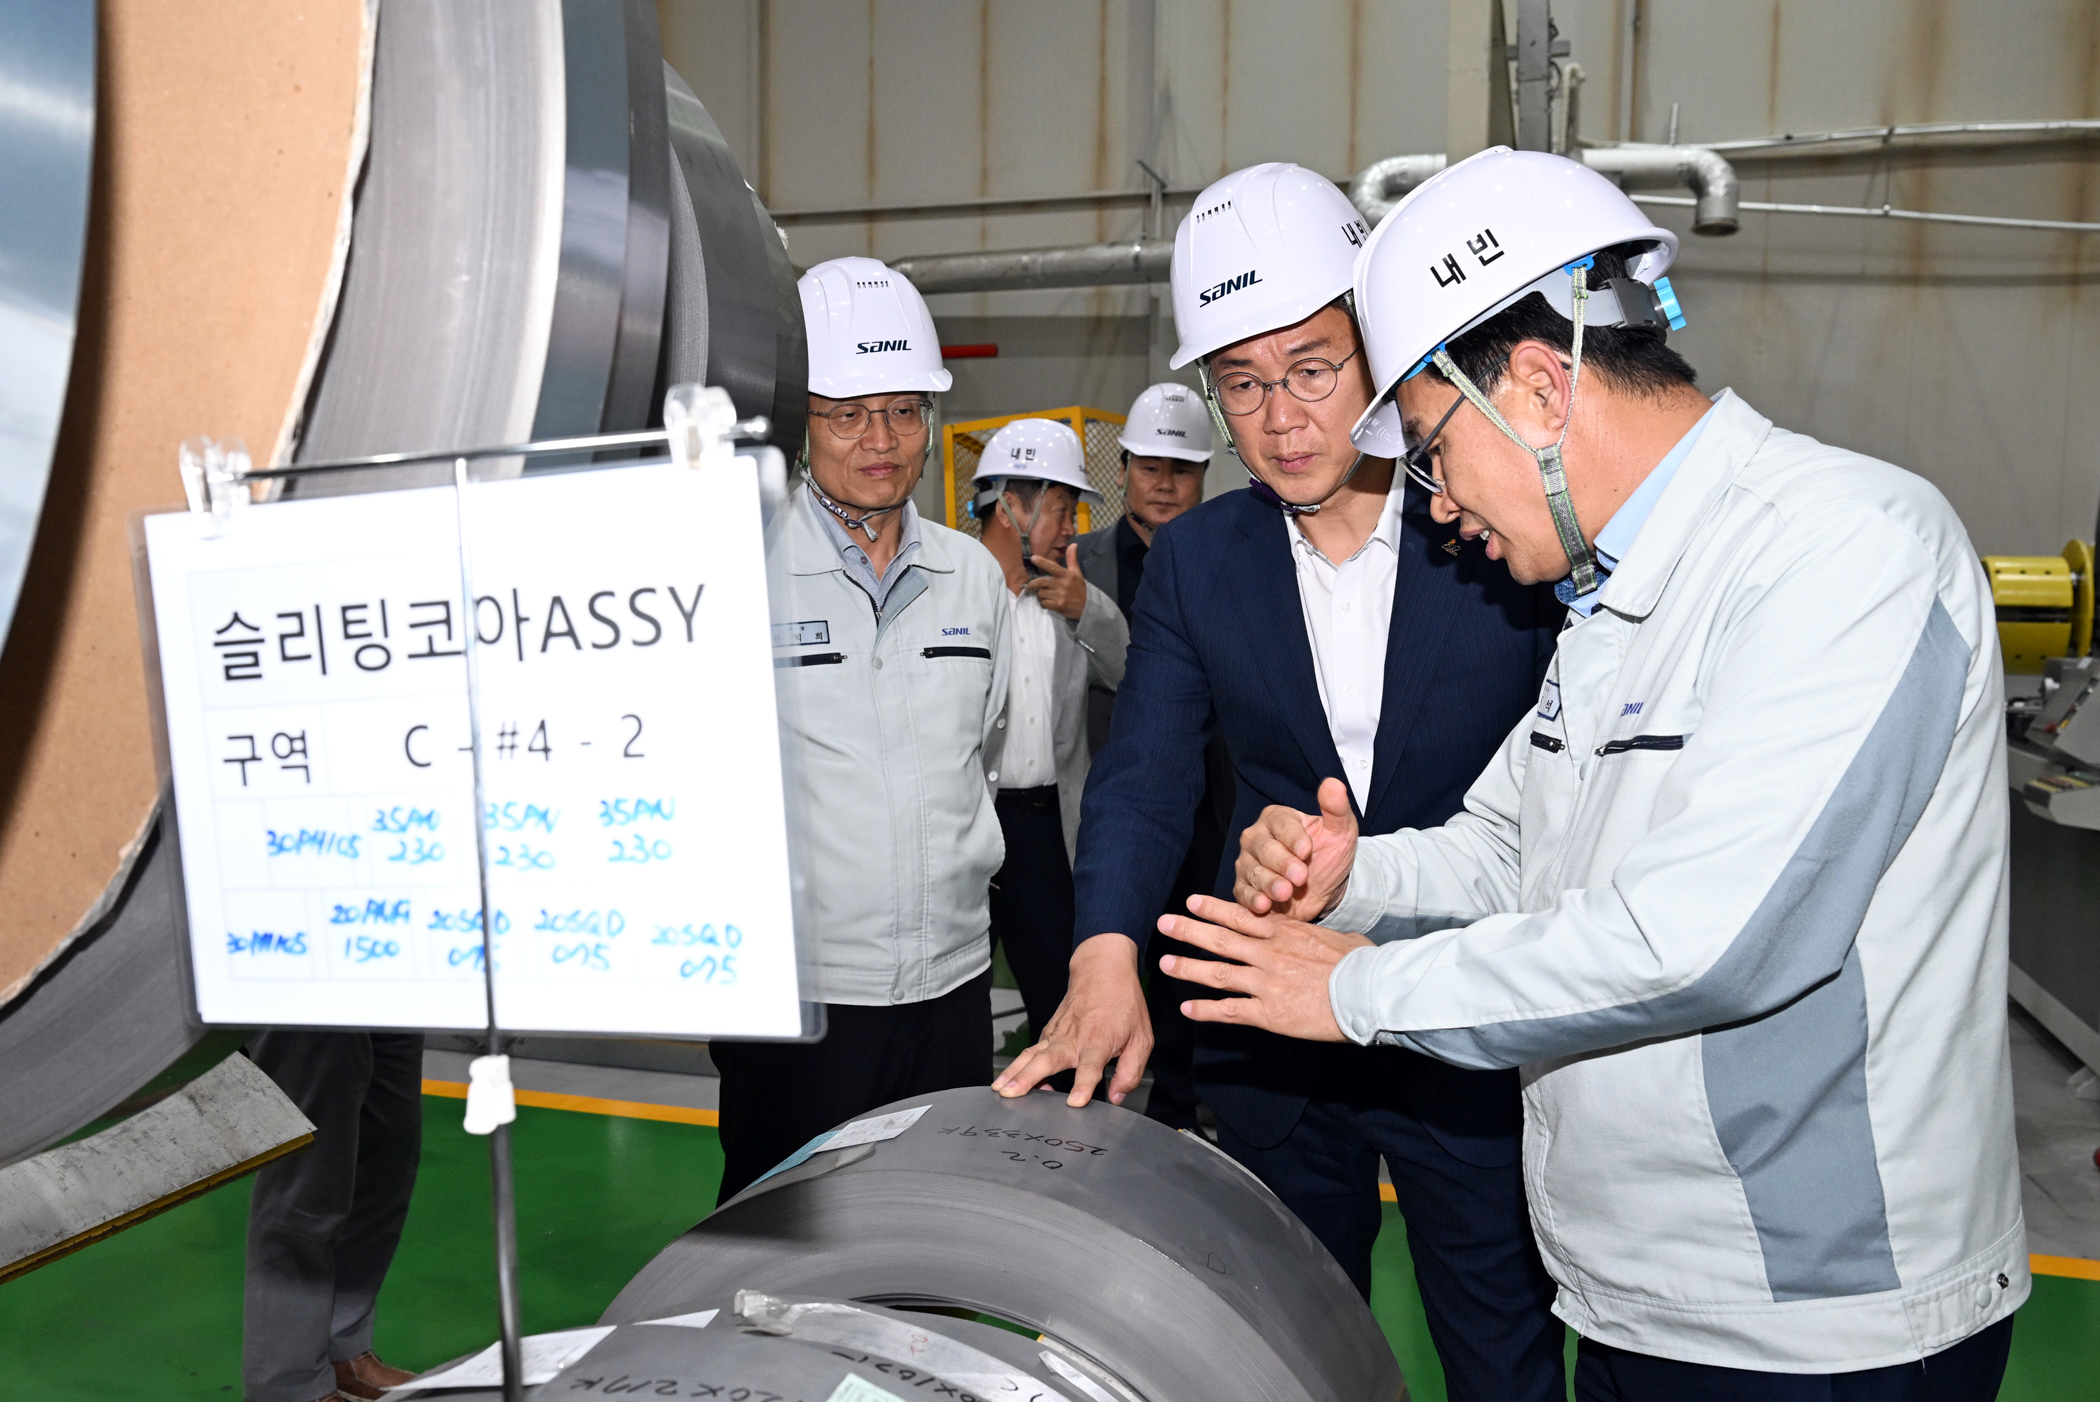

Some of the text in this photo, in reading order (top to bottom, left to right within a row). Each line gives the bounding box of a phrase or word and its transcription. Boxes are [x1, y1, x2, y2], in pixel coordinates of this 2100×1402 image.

[1429, 228, 1505, 288] 내빈
[1010, 447, 1036, 461] 내빈
[223, 729, 311, 787] 구역
[388, 837, 445, 865] 230
[495, 843, 556, 871] 230
[607, 833, 672, 864] 230
